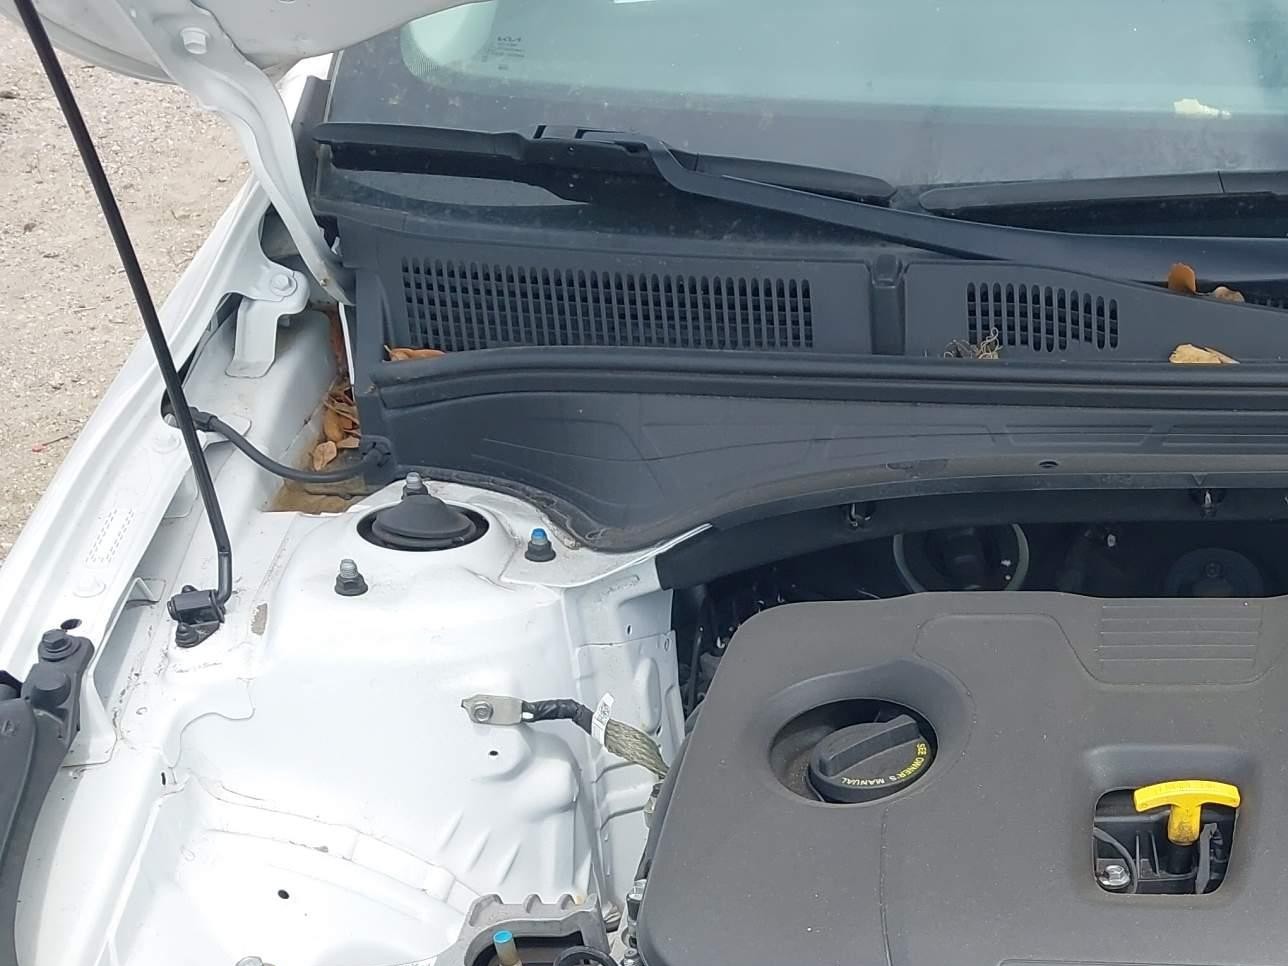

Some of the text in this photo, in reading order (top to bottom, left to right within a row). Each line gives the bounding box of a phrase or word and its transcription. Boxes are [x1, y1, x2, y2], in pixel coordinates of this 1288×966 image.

[841, 744, 927, 786] SEE OWNER'S MANUAL
